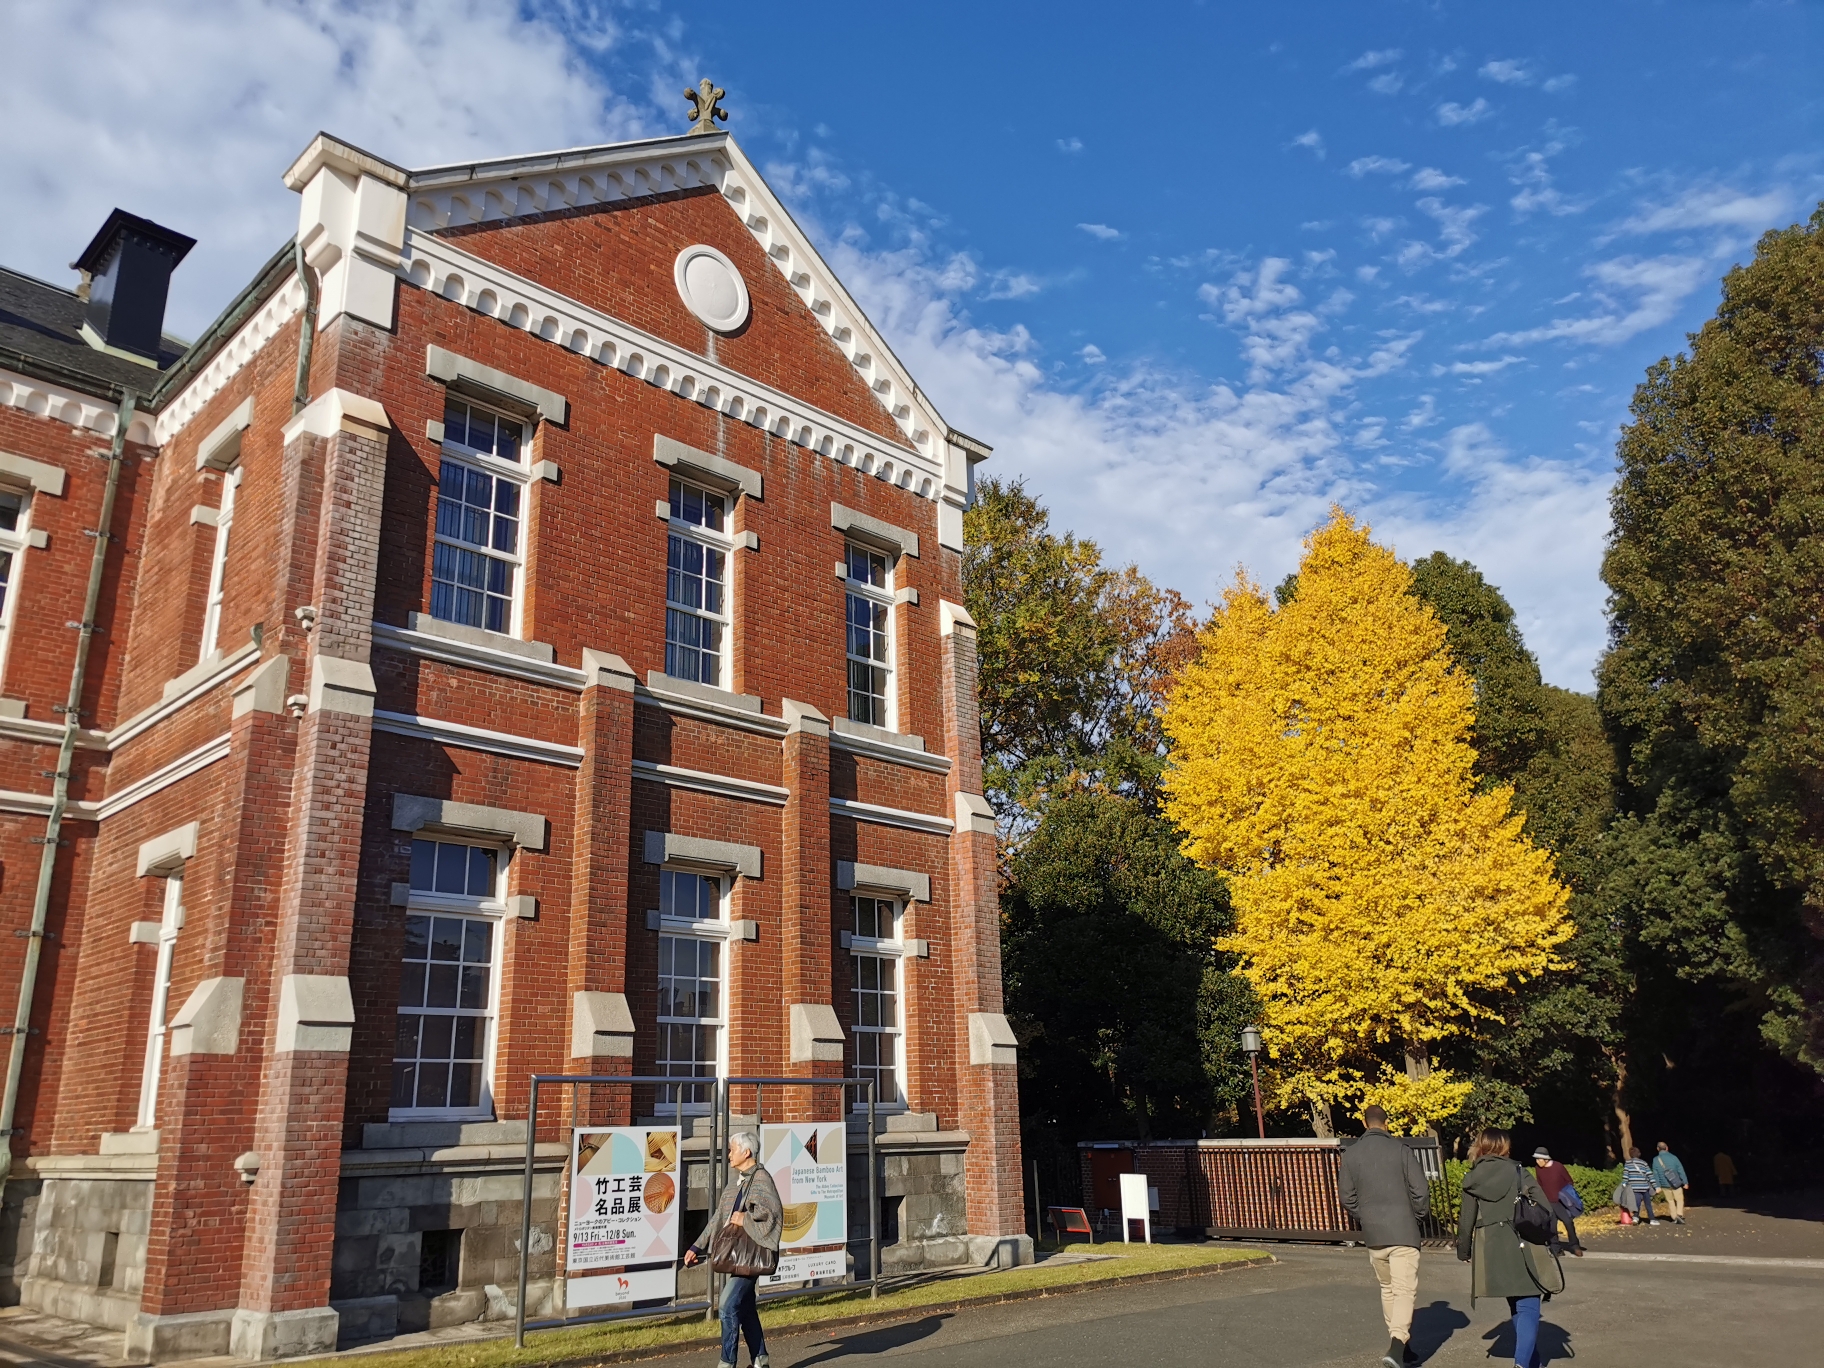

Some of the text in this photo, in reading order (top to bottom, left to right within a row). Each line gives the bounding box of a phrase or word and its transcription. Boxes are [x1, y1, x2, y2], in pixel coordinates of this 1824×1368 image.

[792, 1168, 814, 1176] Japanese
[595, 1176, 642, 1195] 竹工芸
[804, 1176, 816, 1184] New
[816, 1174, 828, 1182] York
[594, 1196, 642, 1216] 名品展
[573, 1232, 589, 1242] 9/13
[622, 1229, 636, 1239] Sun.
